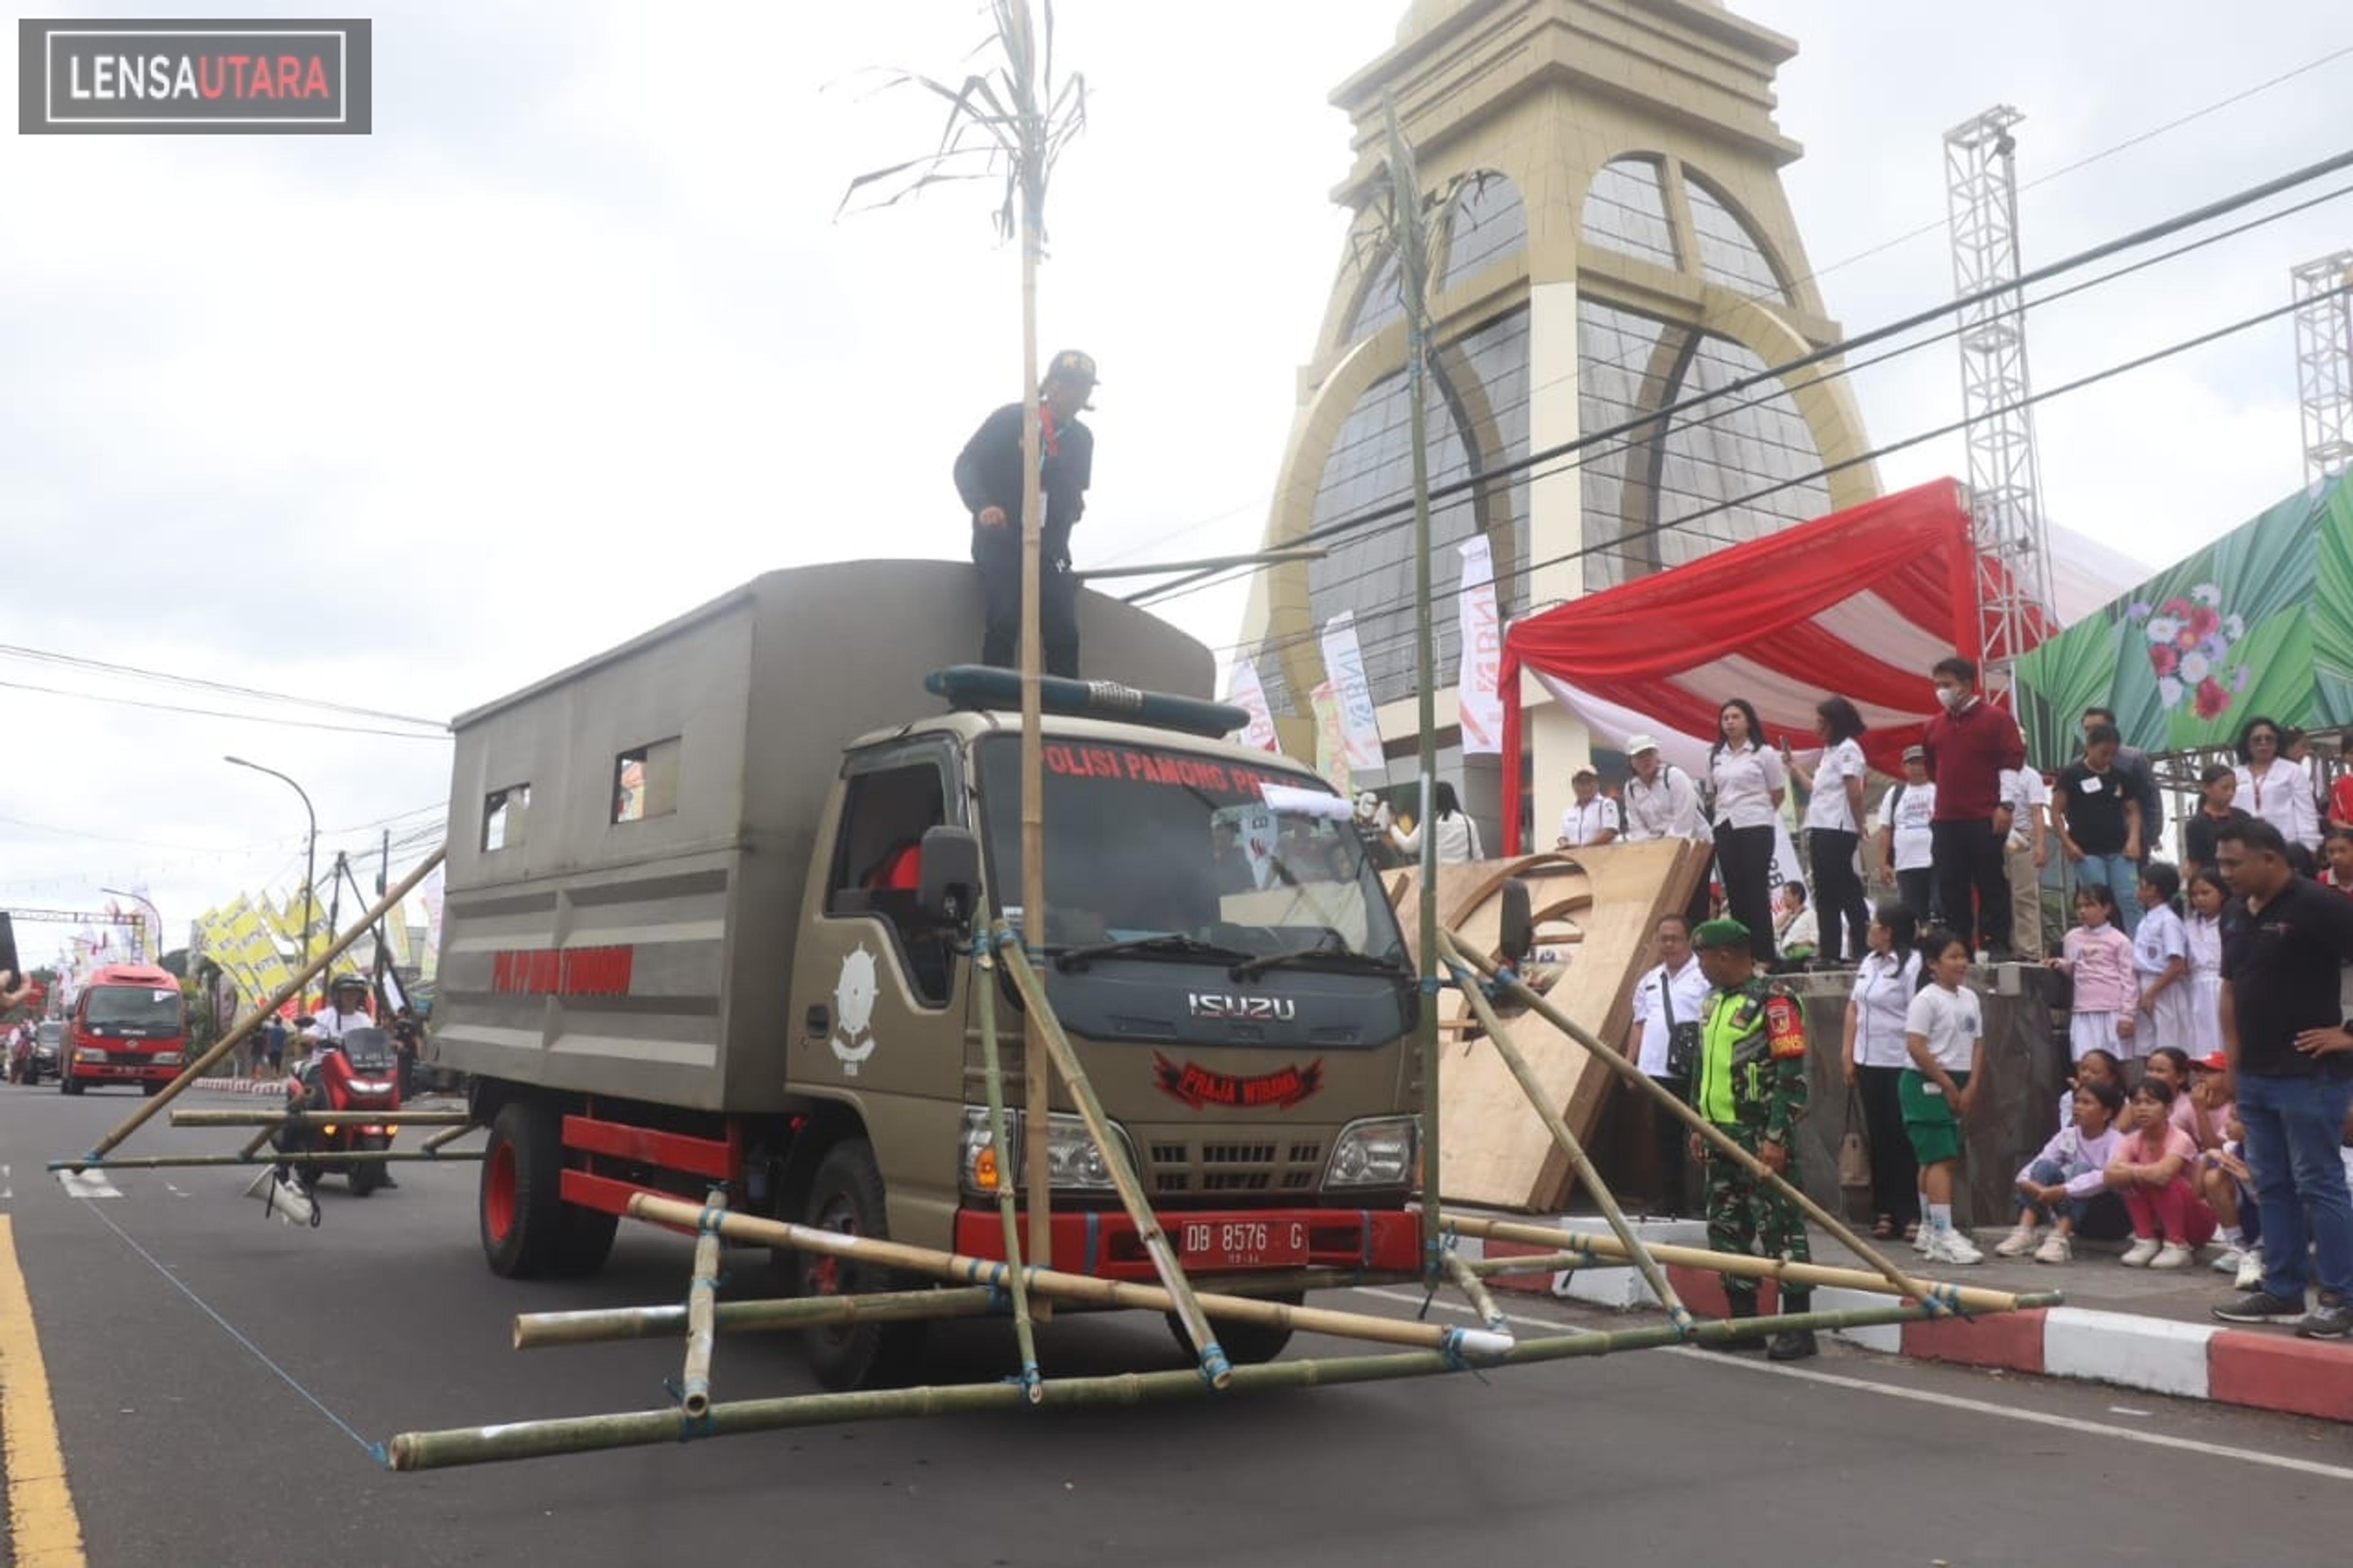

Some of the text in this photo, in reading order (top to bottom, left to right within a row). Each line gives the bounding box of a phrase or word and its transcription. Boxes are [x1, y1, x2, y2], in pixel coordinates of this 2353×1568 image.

[1042, 744, 1122, 779] OLISI
[1124, 750, 1229, 791] PAMONG
[1189, 993, 1295, 1021] ISUZU
[1186, 1222, 1303, 1251] DB 8576 G
